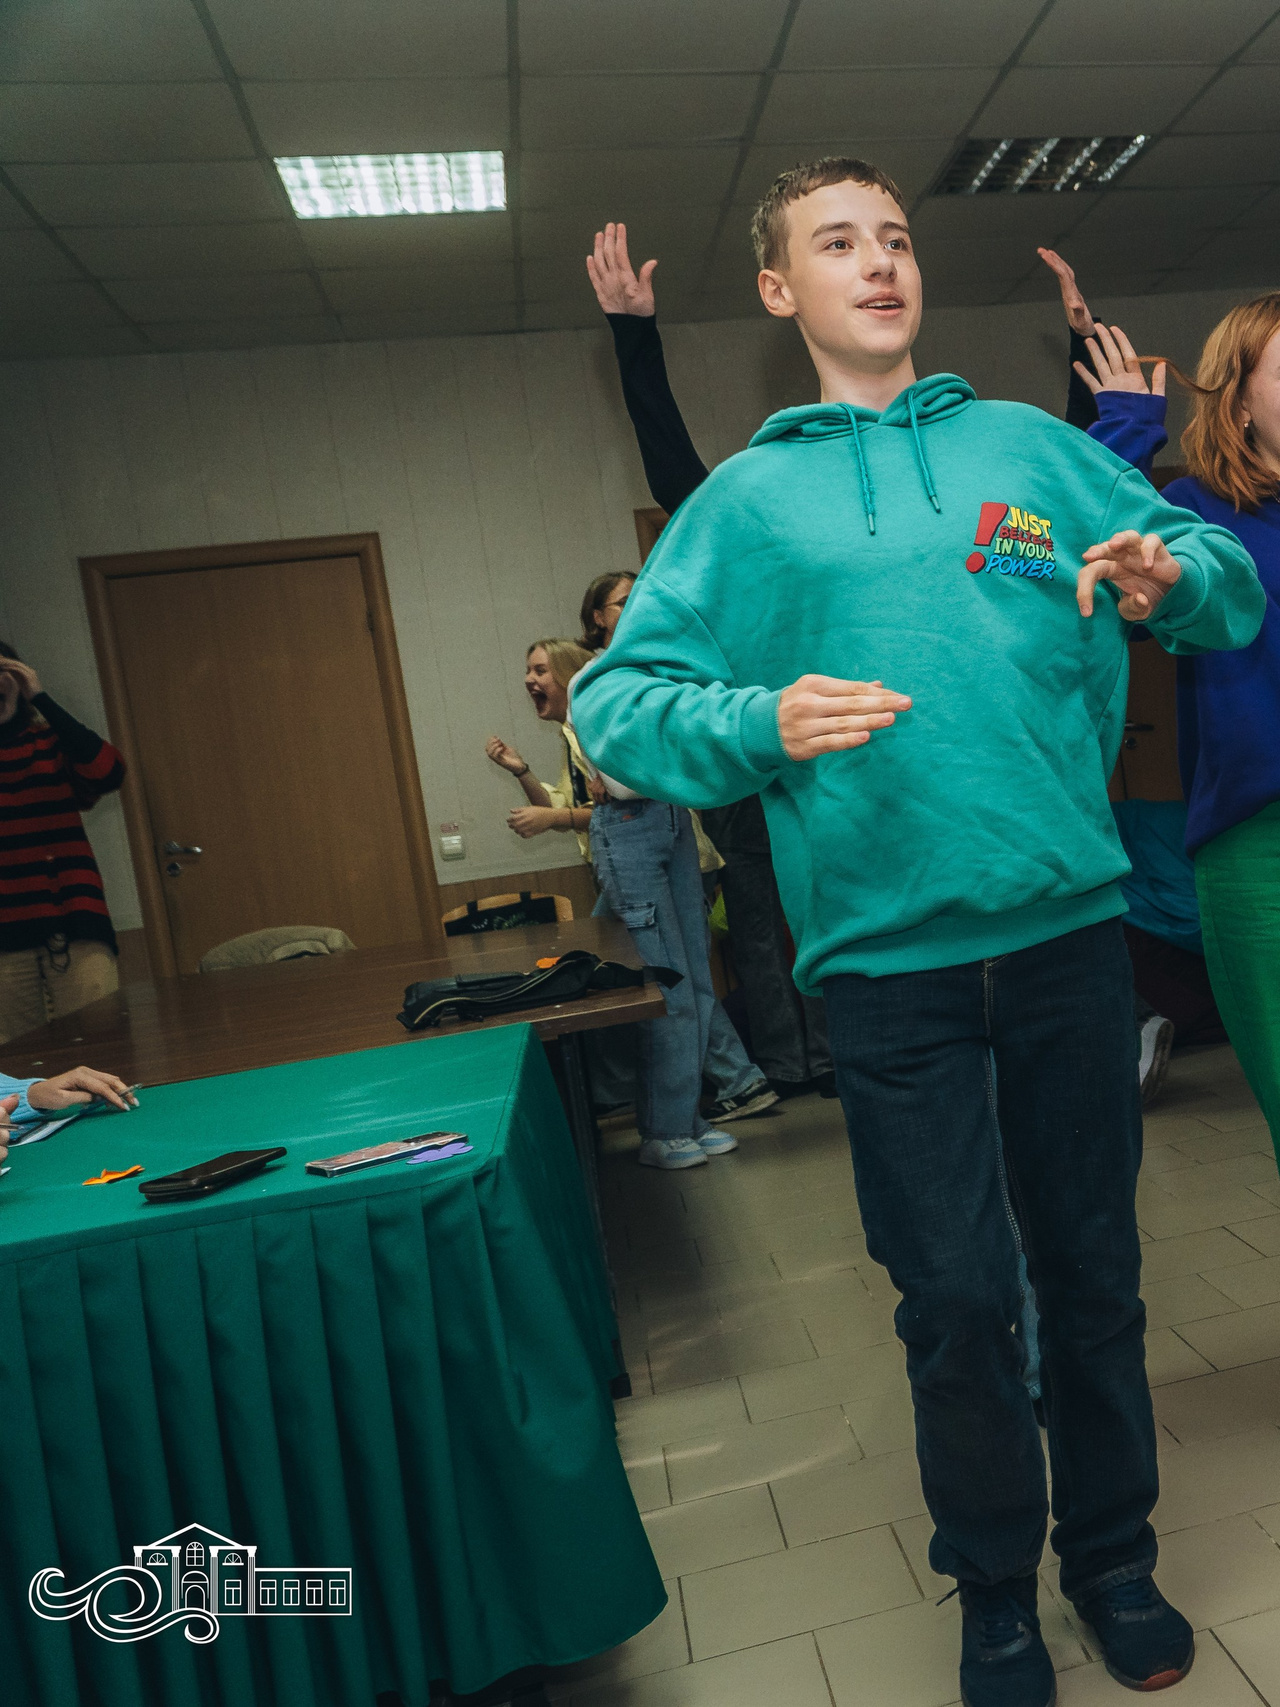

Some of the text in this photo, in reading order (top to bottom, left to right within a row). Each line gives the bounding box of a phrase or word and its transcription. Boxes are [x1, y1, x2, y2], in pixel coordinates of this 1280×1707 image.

[1007, 506, 1052, 539] JUST
[994, 538, 1055, 562] IN YOUR
[984, 554, 1056, 580] POWER
